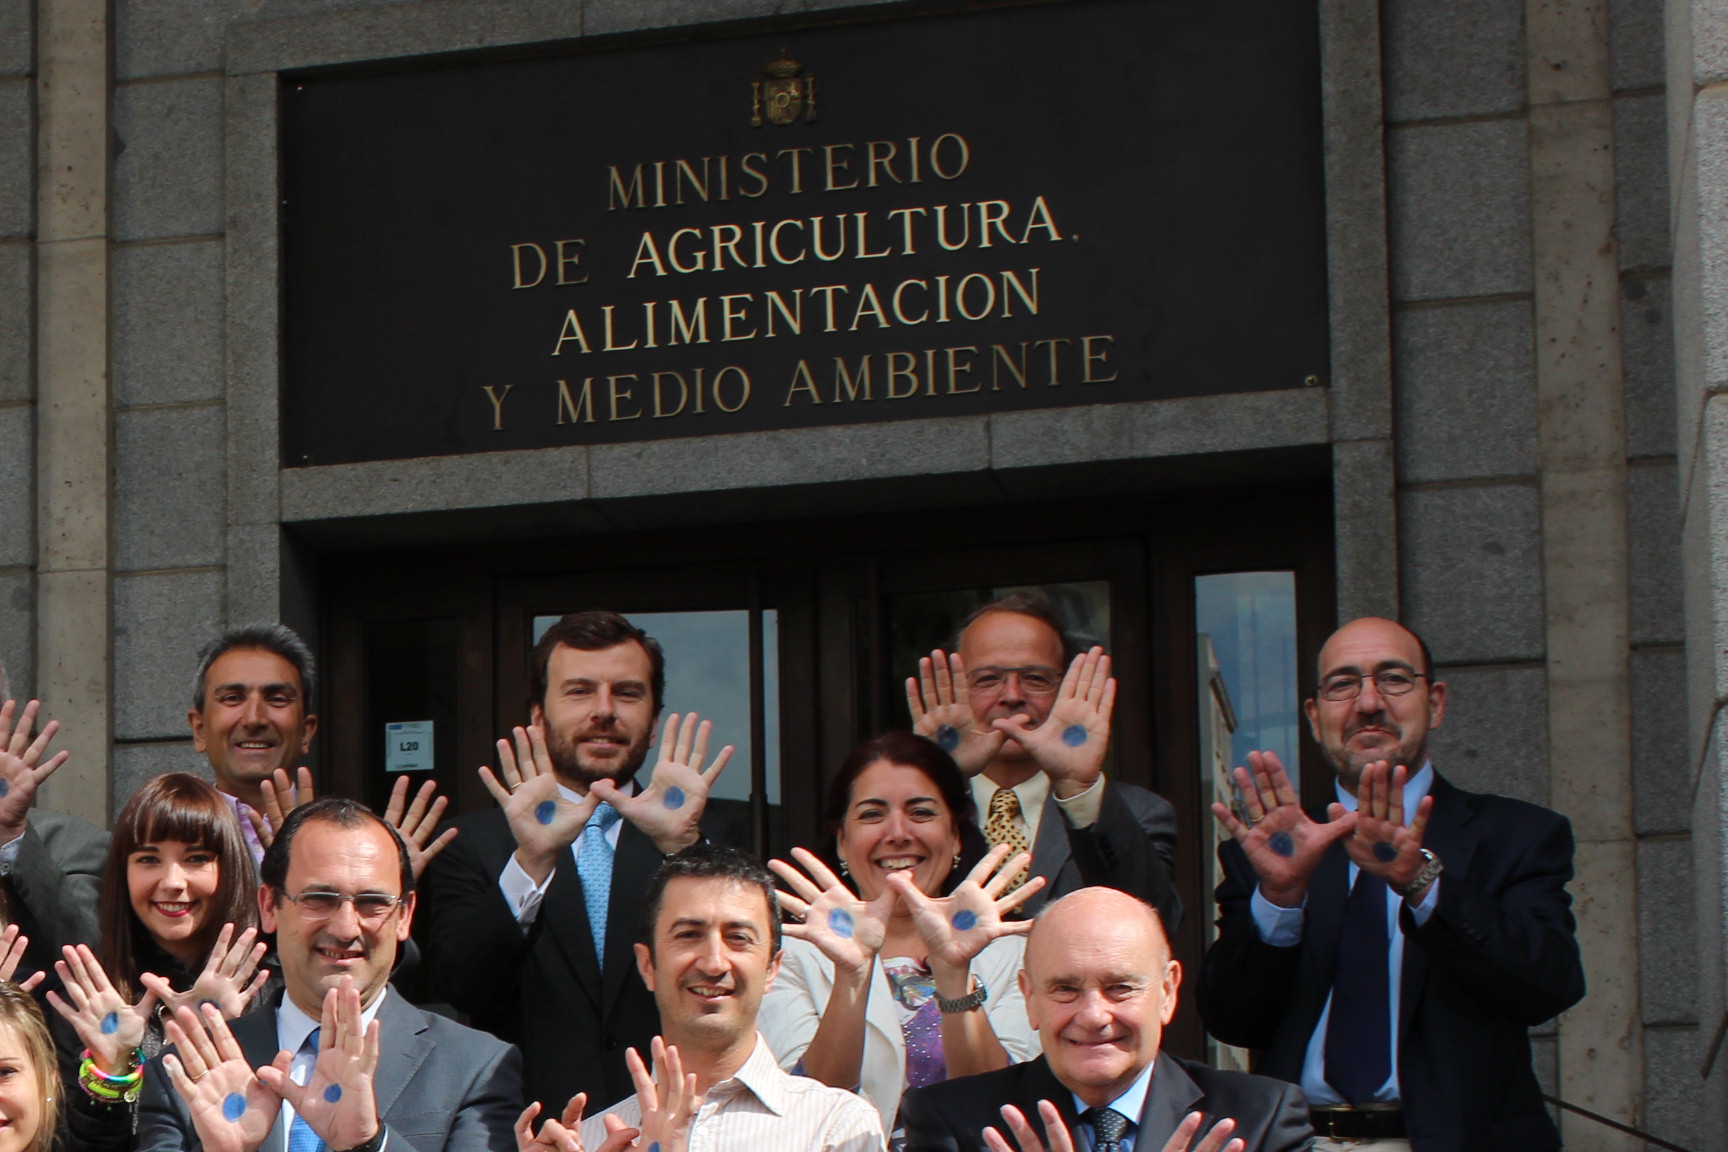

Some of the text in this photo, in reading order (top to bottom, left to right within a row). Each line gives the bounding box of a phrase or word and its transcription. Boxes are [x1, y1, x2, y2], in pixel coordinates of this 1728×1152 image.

[608, 132, 971, 211] MINISTERIO
[511, 238, 589, 290] DE
[550, 267, 1042, 356] ALIMENTACION
[482, 335, 1119, 431] Y MEDIO AMBIENTE
[399, 741, 419, 752] L20
